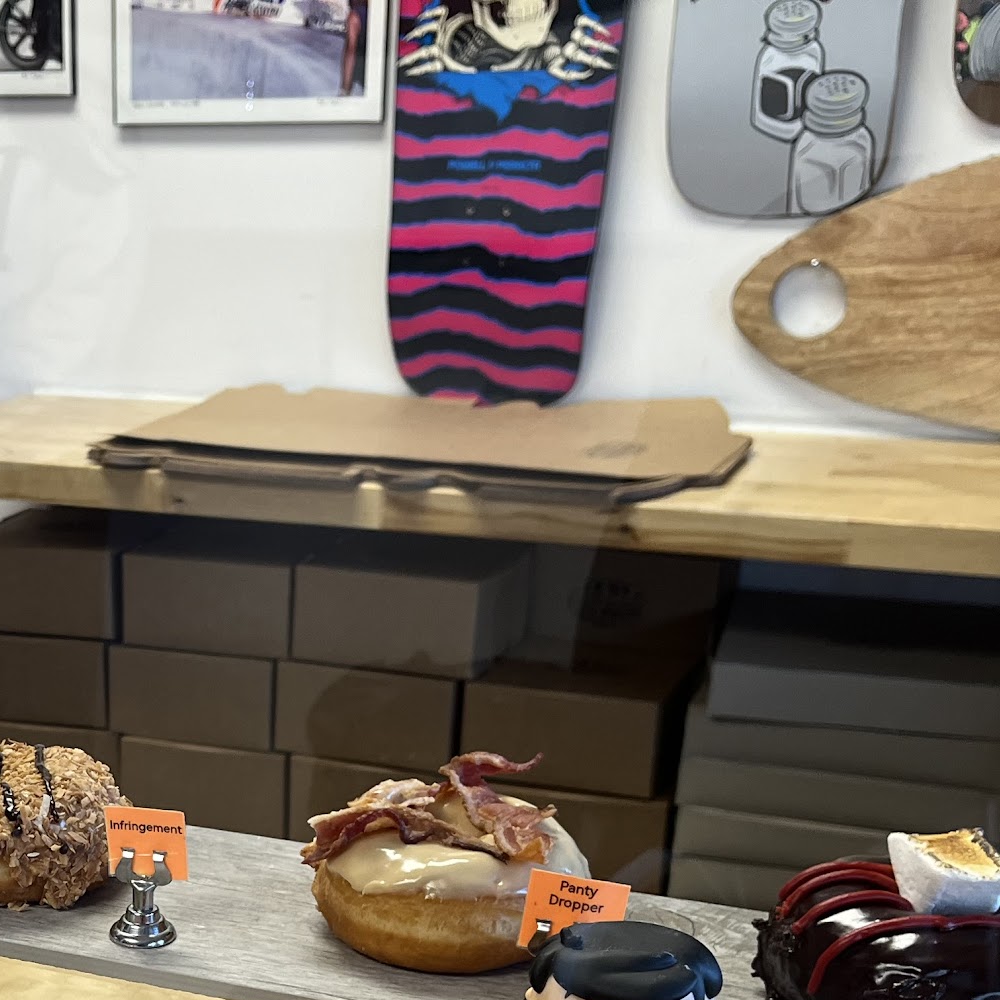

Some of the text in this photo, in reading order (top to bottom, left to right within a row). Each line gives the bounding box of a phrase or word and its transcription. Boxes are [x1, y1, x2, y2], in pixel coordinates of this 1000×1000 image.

[110, 820, 183, 834] Infringement
[560, 880, 599, 899] Panty
[549, 894, 604, 914] Dropper
